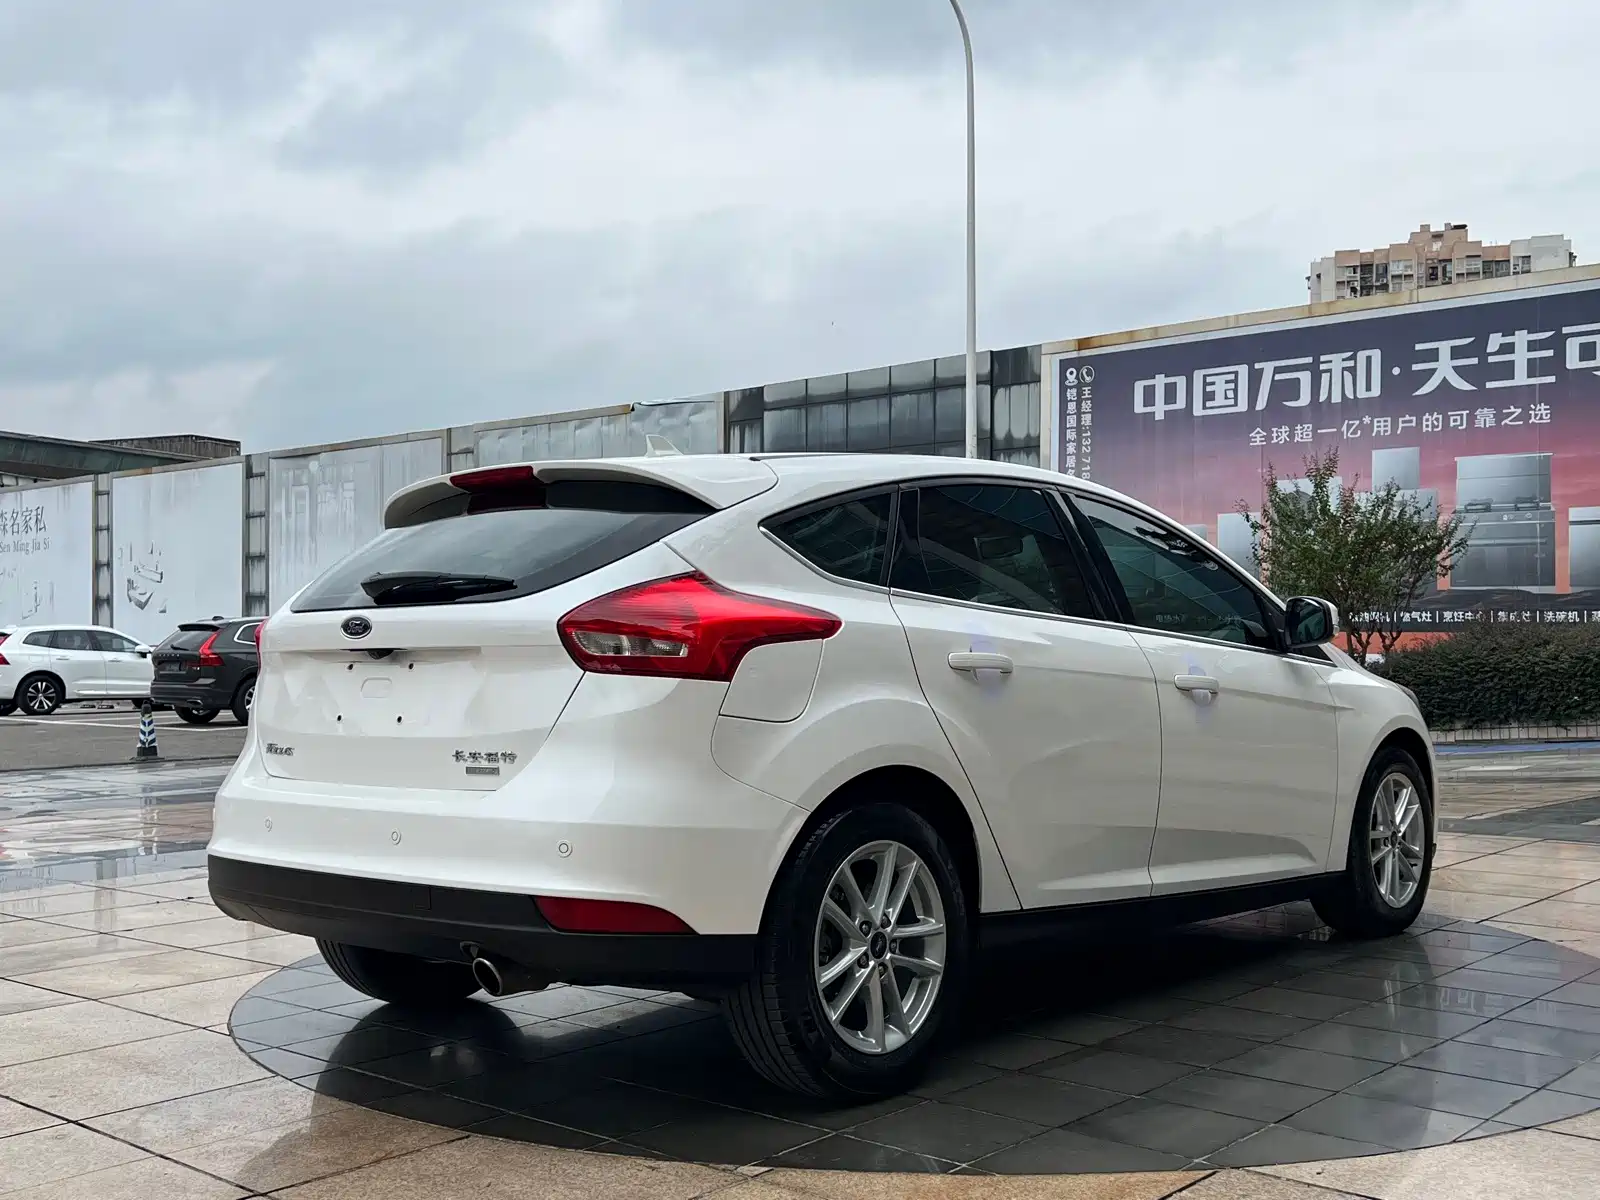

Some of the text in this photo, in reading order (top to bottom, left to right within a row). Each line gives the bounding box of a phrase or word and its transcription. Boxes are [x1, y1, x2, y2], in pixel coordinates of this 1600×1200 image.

[1543, 610, 1580, 623] 洗碗机
[451, 749, 518, 765] 长安福特
